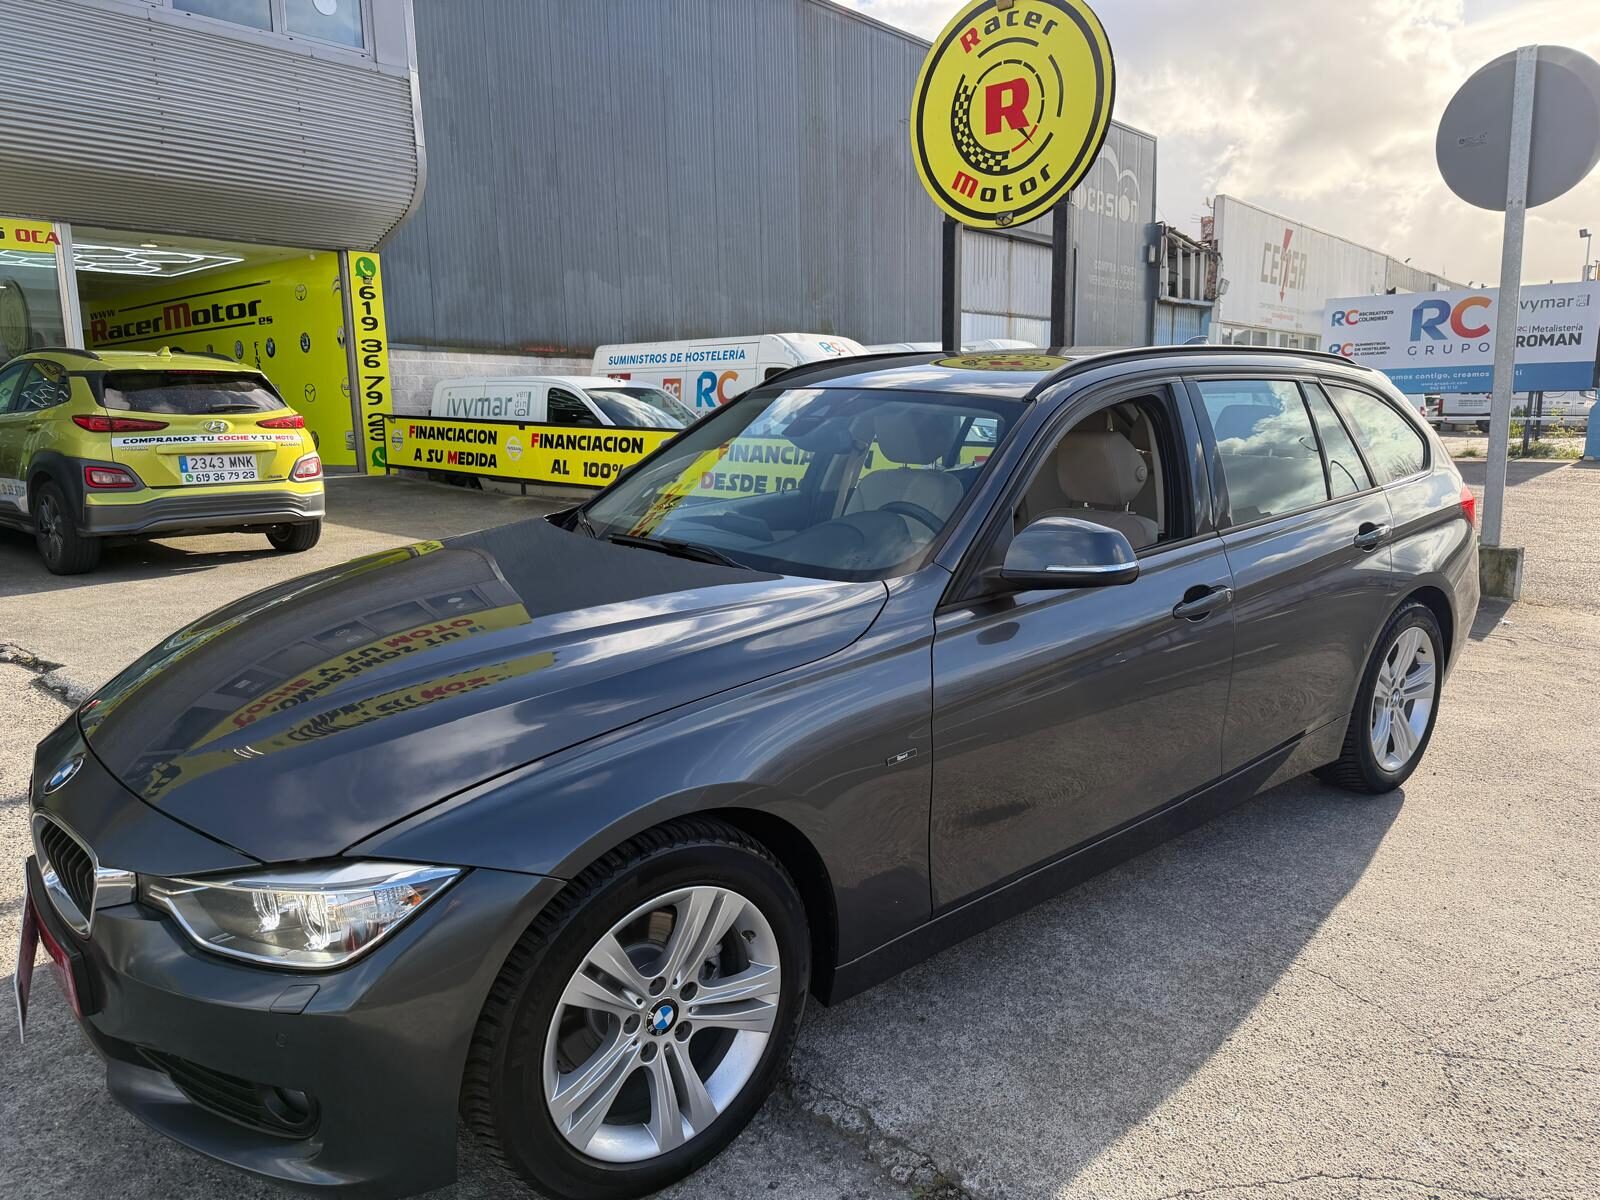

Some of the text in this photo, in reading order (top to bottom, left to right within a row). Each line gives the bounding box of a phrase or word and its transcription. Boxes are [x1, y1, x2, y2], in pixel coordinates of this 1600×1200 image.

[959, 10, 1058, 54] Racer
[985, 77, 1030, 136] R
[951, 163, 1051, 203] Motor
[1519, 297, 1575, 313] vymar
[90, 299, 262, 343] RacerMotor
[258, 315, 274, 326] es
[1331, 309, 1360, 327] RC
[1409, 296, 1492, 341] RC
[1328, 342, 1354, 357] RC
[1407, 342, 1490, 356] GRUPO
[1515, 332, 1582, 348] ROMAN
[608, 346, 746, 365] SUMINISTROS DE HOSTELERÍA
[696, 370, 739, 408] RC
[446, 391, 513, 418] ivymar
[122, 436, 197, 445] COMPRAMOS
[409, 425, 497, 445] FINANCIACION
[531, 433, 644, 454] FINANCIACION
[191, 456, 254, 470] 2343 MNK
[413, 448, 497, 468] A SU MEDIDA
[551, 459, 570, 475] AL
[196, 471, 256, 482] 619 36 79 23
[700, 471, 769, 493] DESDE
